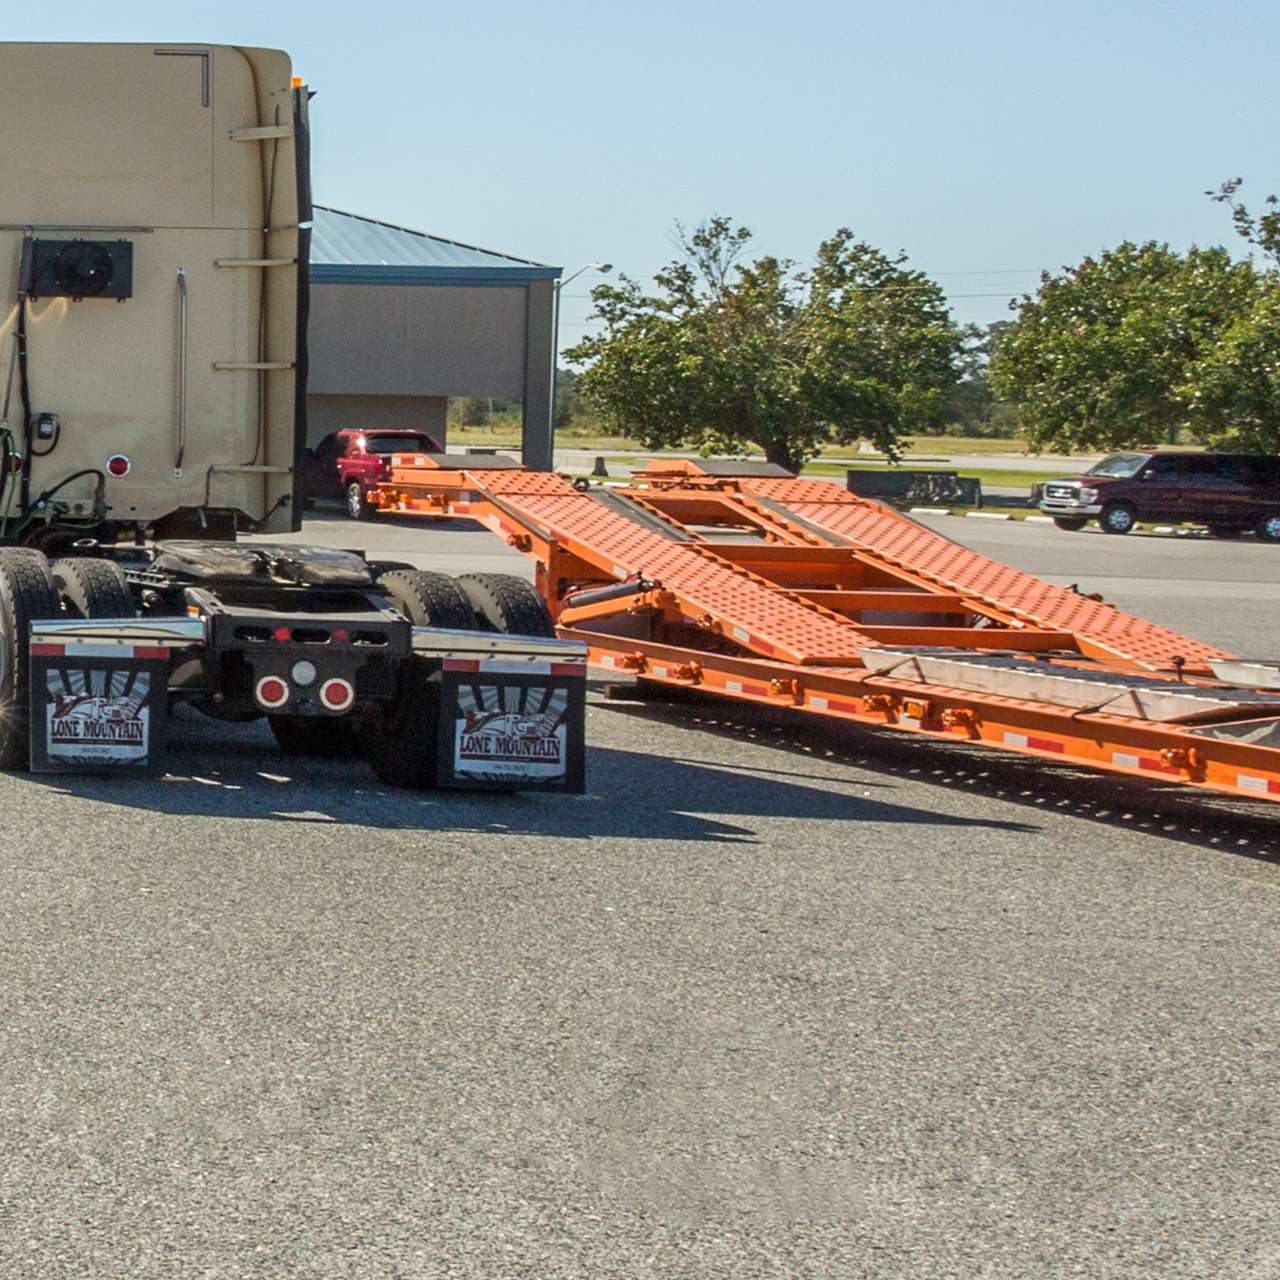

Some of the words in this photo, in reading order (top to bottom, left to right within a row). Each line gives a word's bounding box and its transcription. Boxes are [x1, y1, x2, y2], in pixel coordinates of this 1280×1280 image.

[50, 720, 80, 737] LONE
[83, 720, 145, 739] MOUNTAIN
[460, 735, 492, 753] LONE
[495, 736, 560, 758] MOUNTAIN
